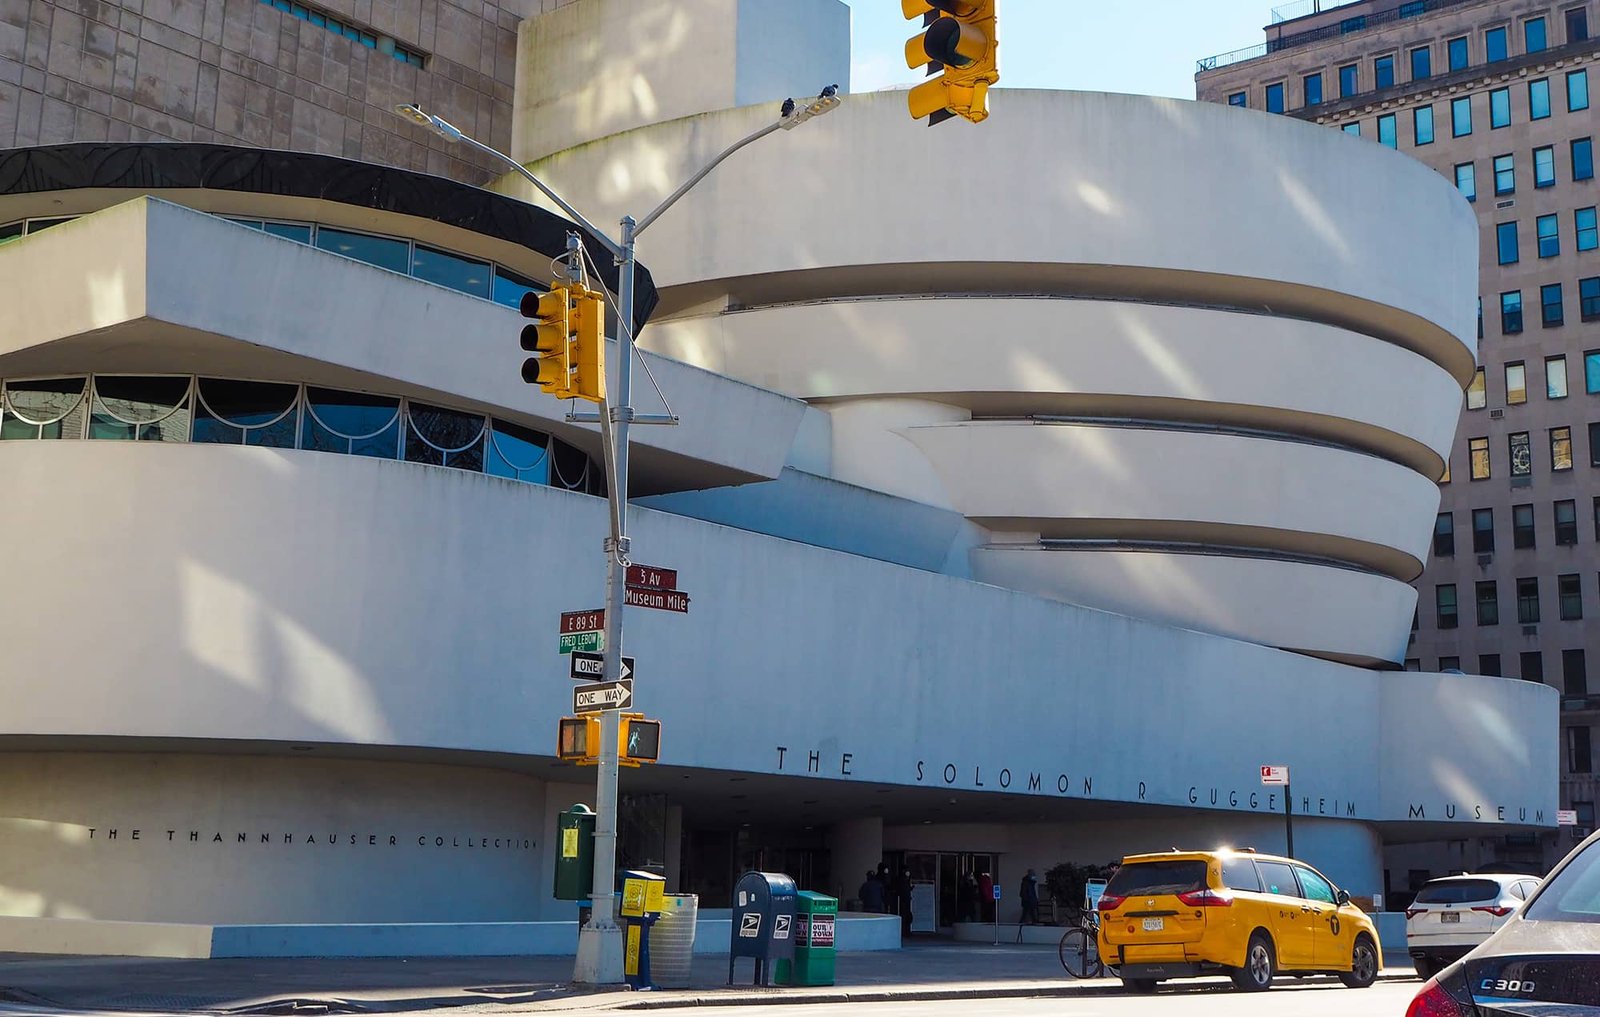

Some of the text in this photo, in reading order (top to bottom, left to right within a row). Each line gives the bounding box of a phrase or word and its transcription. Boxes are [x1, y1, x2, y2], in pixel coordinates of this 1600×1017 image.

[640, 568, 661, 586] 5 Av
[625, 589, 687, 610] Museum Mile
[568, 615, 598, 631] E 89 St
[560, 633, 597, 647] FRED LEBOW
[580, 660, 599, 673] ONE
[578, 688, 624, 706] ONE WAY
[776, 747, 853, 776] THE
[916, 760, 1093, 795] SOLOMON
[1138, 781, 1147, 801] R
[1188, 786, 1356, 817] GUGGEHEIM
[1408, 804, 1544, 823] MUSEUM
[88, 828, 538, 849] THE THANNHAUSER COLLECTION
